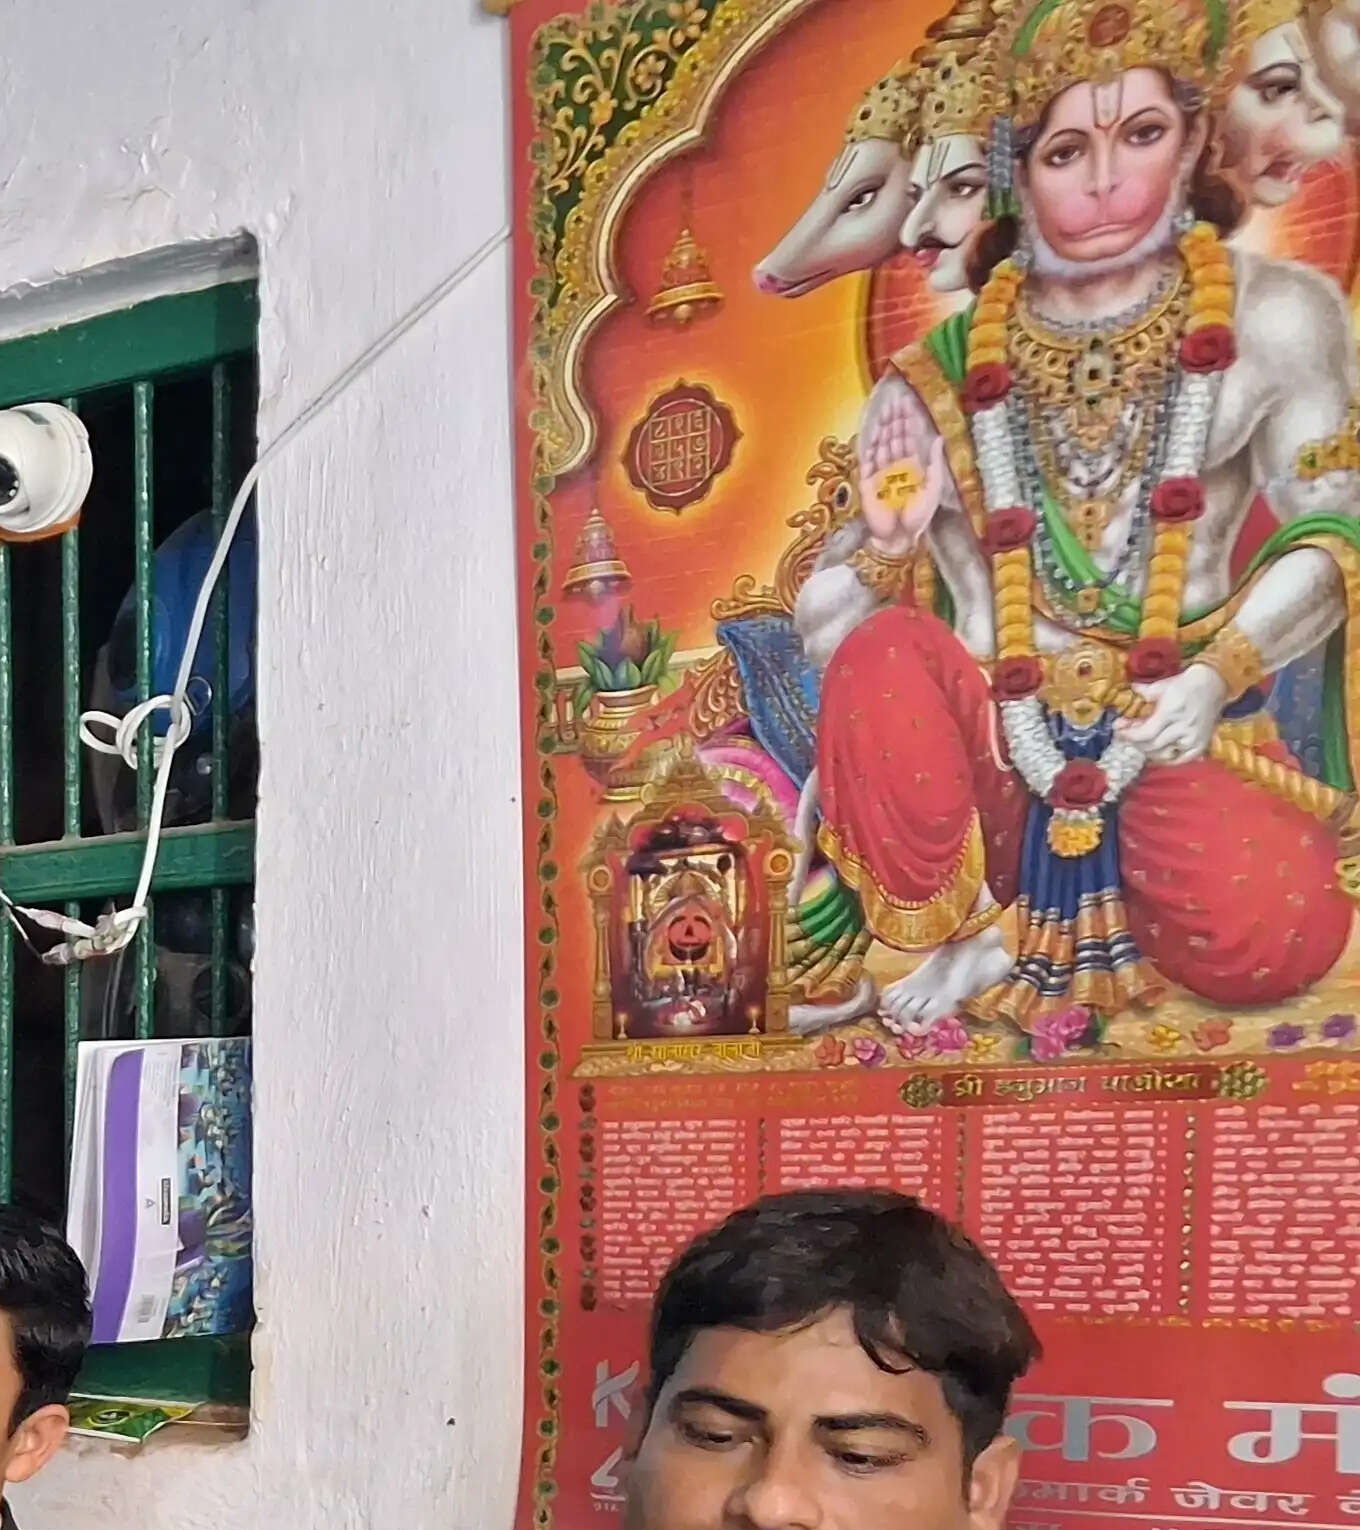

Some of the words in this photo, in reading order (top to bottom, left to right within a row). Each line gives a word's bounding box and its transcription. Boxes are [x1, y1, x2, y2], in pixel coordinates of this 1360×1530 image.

[1002, 1392, 1174, 1462] क
[1016, 1477, 1150, 1505] मार्क
[1170, 1481, 1316, 1515] जेवर
